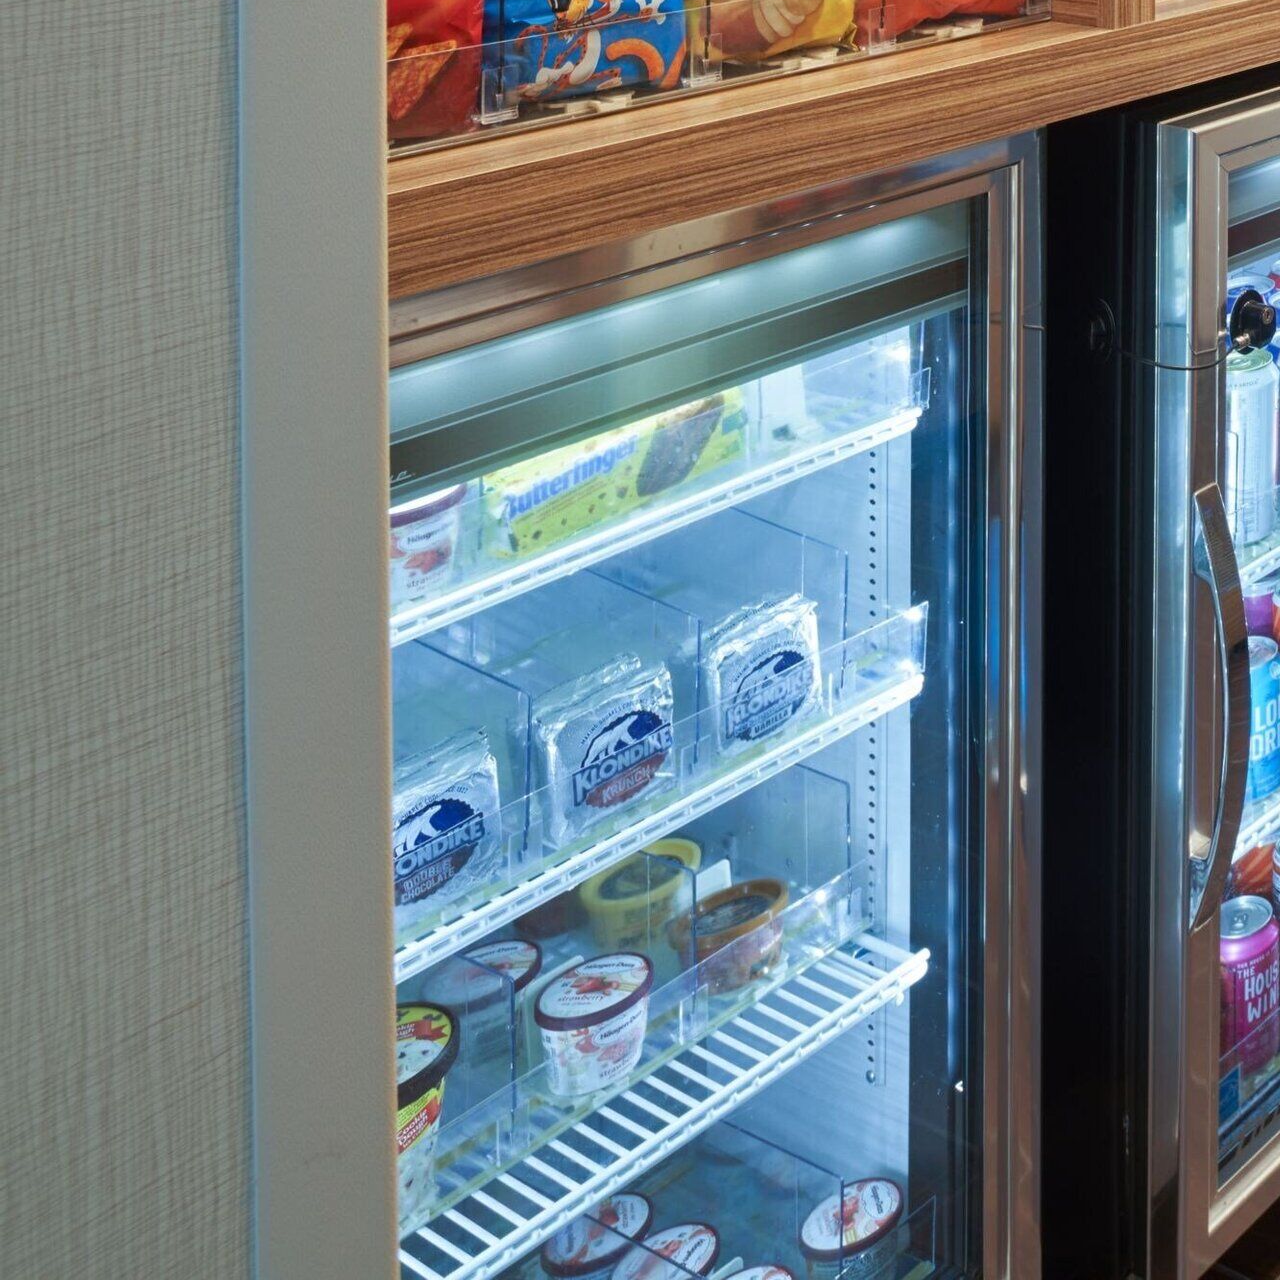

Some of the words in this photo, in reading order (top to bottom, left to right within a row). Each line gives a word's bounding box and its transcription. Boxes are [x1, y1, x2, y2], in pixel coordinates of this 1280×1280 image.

[754, 708, 789, 734] VANILLA
[573, 727, 672, 806] KLONDIKE
[1237, 966, 1255, 978] THE
